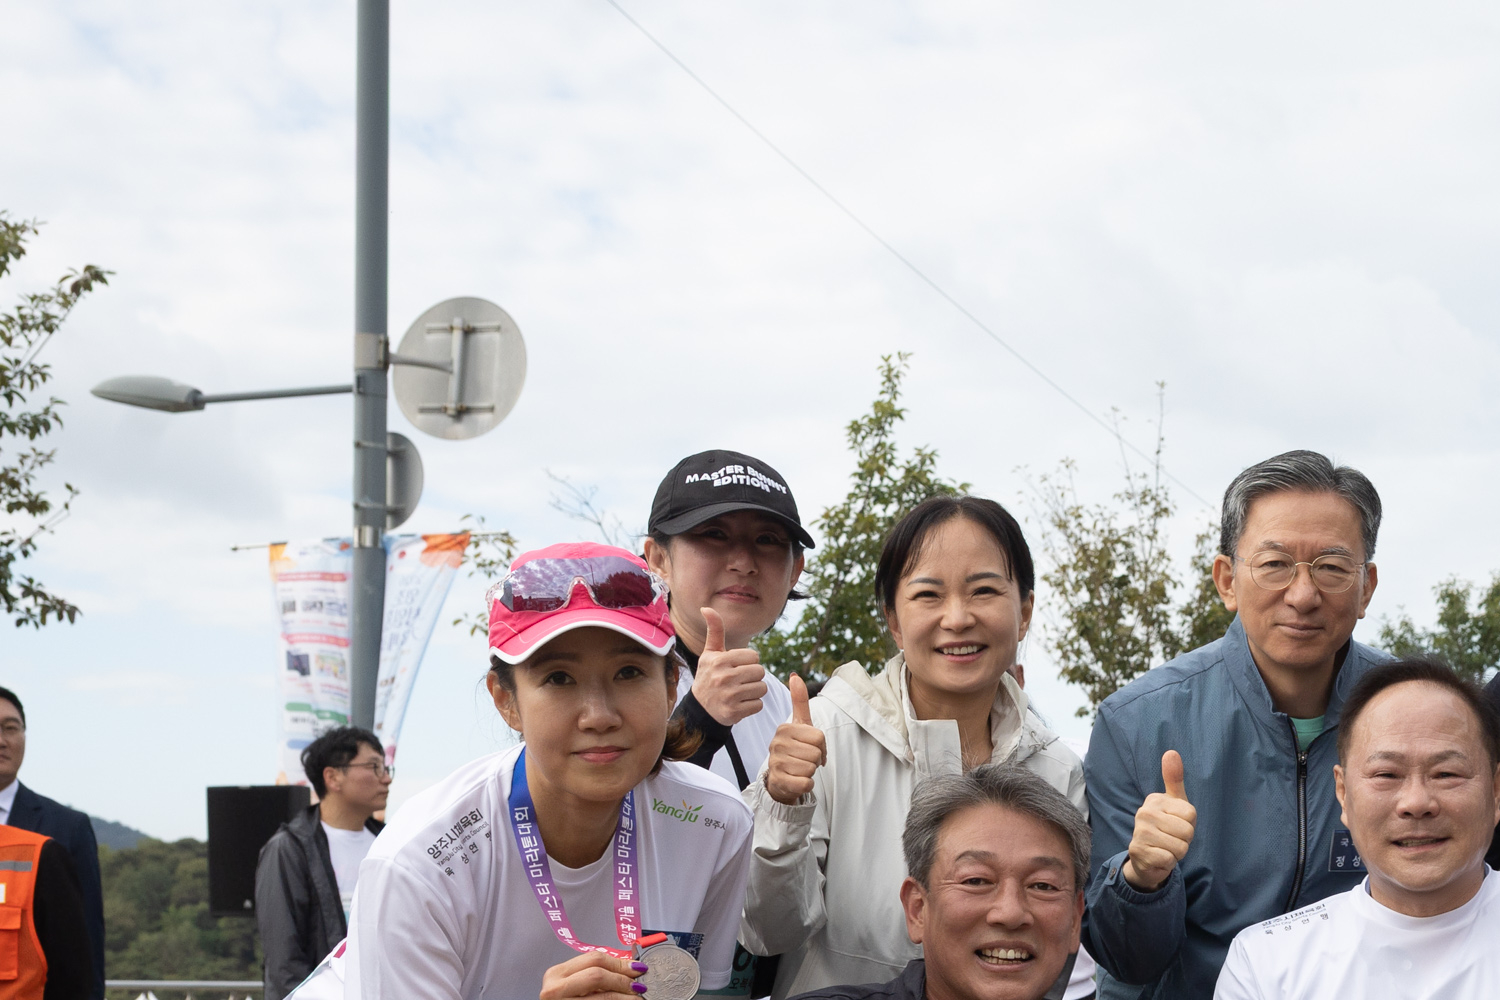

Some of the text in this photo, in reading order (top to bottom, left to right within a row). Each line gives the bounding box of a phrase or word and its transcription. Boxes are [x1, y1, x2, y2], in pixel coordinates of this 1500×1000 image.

[685, 464, 787, 494] MASTER BUNNY
[713, 474, 771, 493] EDITION
[426, 807, 484, 860] 양주시체육회
[514, 806, 544, 878] 마라톤대회
[1335, 855, 1361, 868] 정성
[617, 862, 634, 901] 페스타
[535, 881, 562, 922] 페스타
[618, 905, 635, 923] 가을
